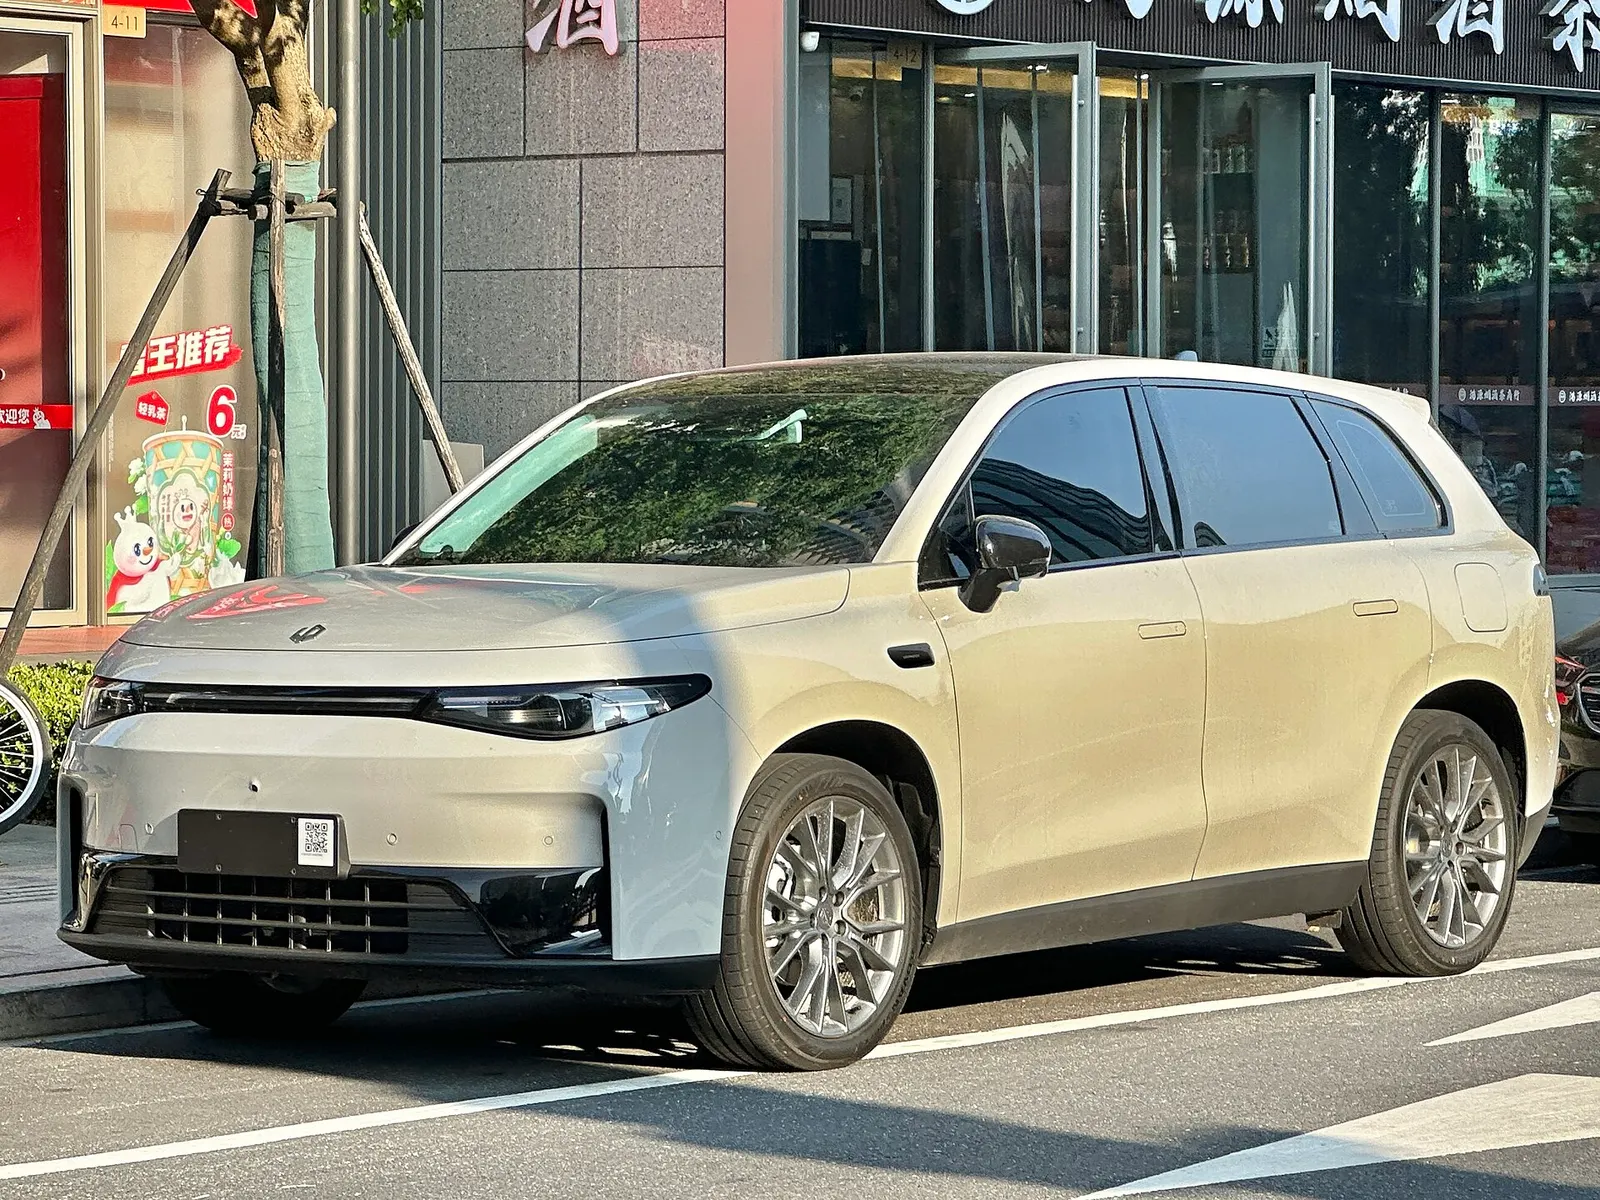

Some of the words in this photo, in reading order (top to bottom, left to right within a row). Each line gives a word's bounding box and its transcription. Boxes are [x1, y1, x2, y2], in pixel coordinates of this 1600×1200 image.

[111, 15, 138, 31] 4-11
[893, 47, 917, 63] 4-12
[138, 402, 166, 420] 轻乳茶
